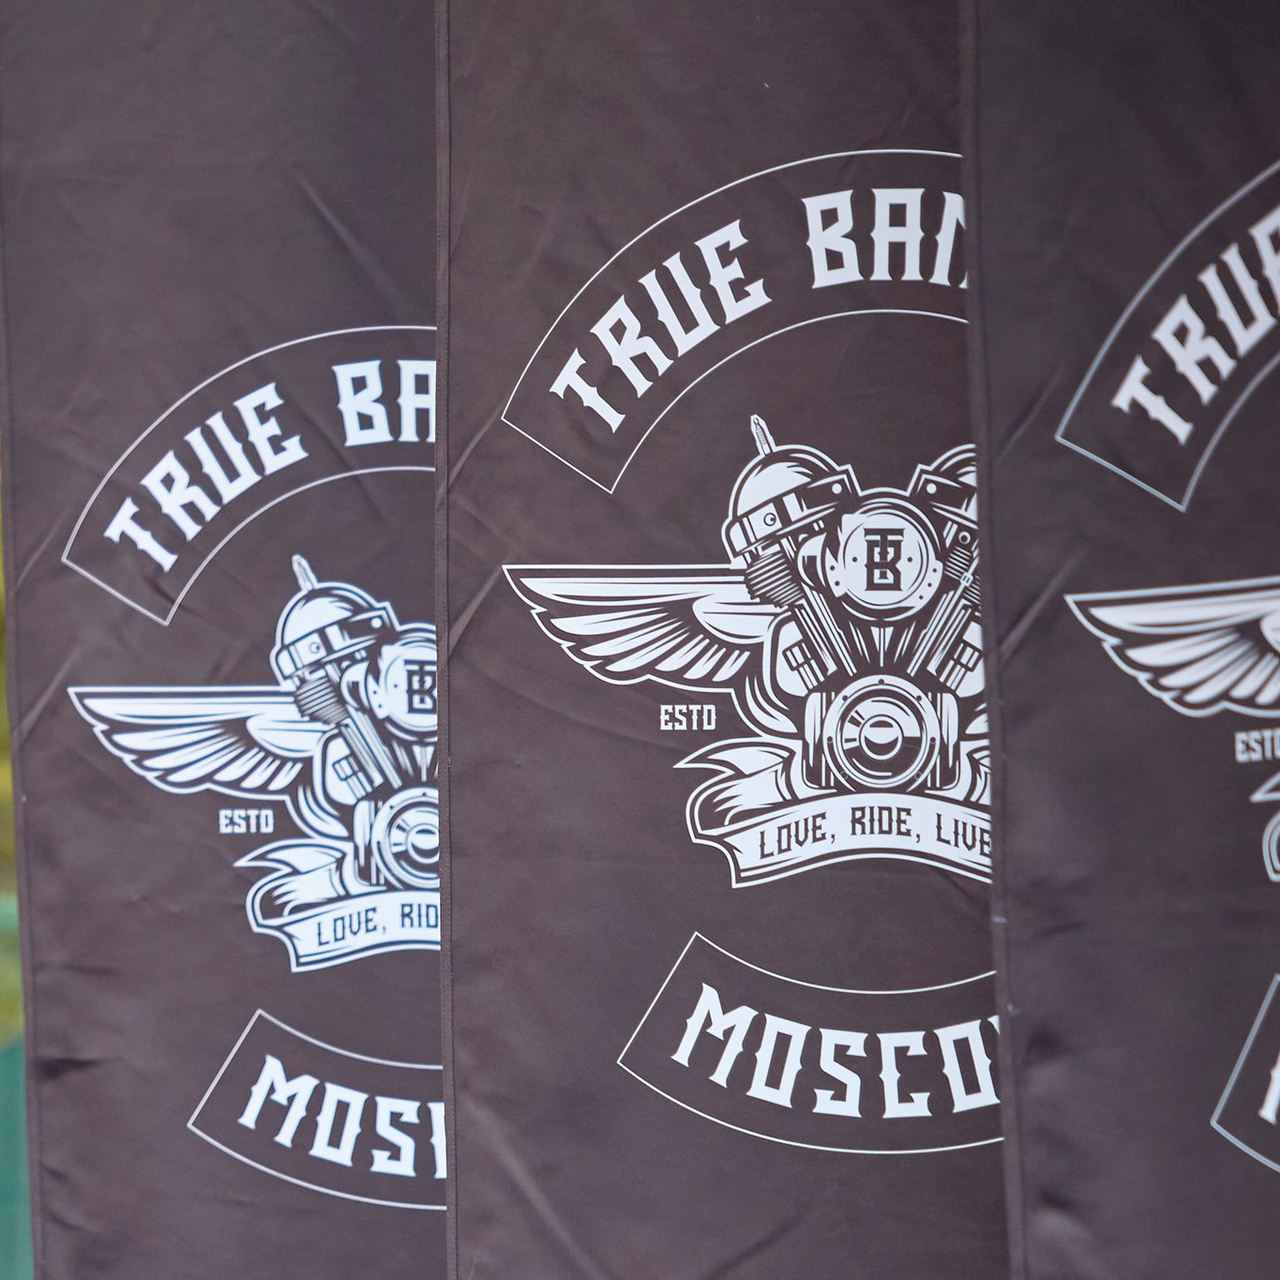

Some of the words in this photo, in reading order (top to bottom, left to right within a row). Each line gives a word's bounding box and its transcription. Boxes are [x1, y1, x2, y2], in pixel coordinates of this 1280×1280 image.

[549, 219, 772, 433] TRUE
[103, 382, 309, 572] TRUE
[659, 704, 716, 731] ESTD
[219, 809, 275, 834] ESTD
[671, 982, 1001, 1118] MOSCO
